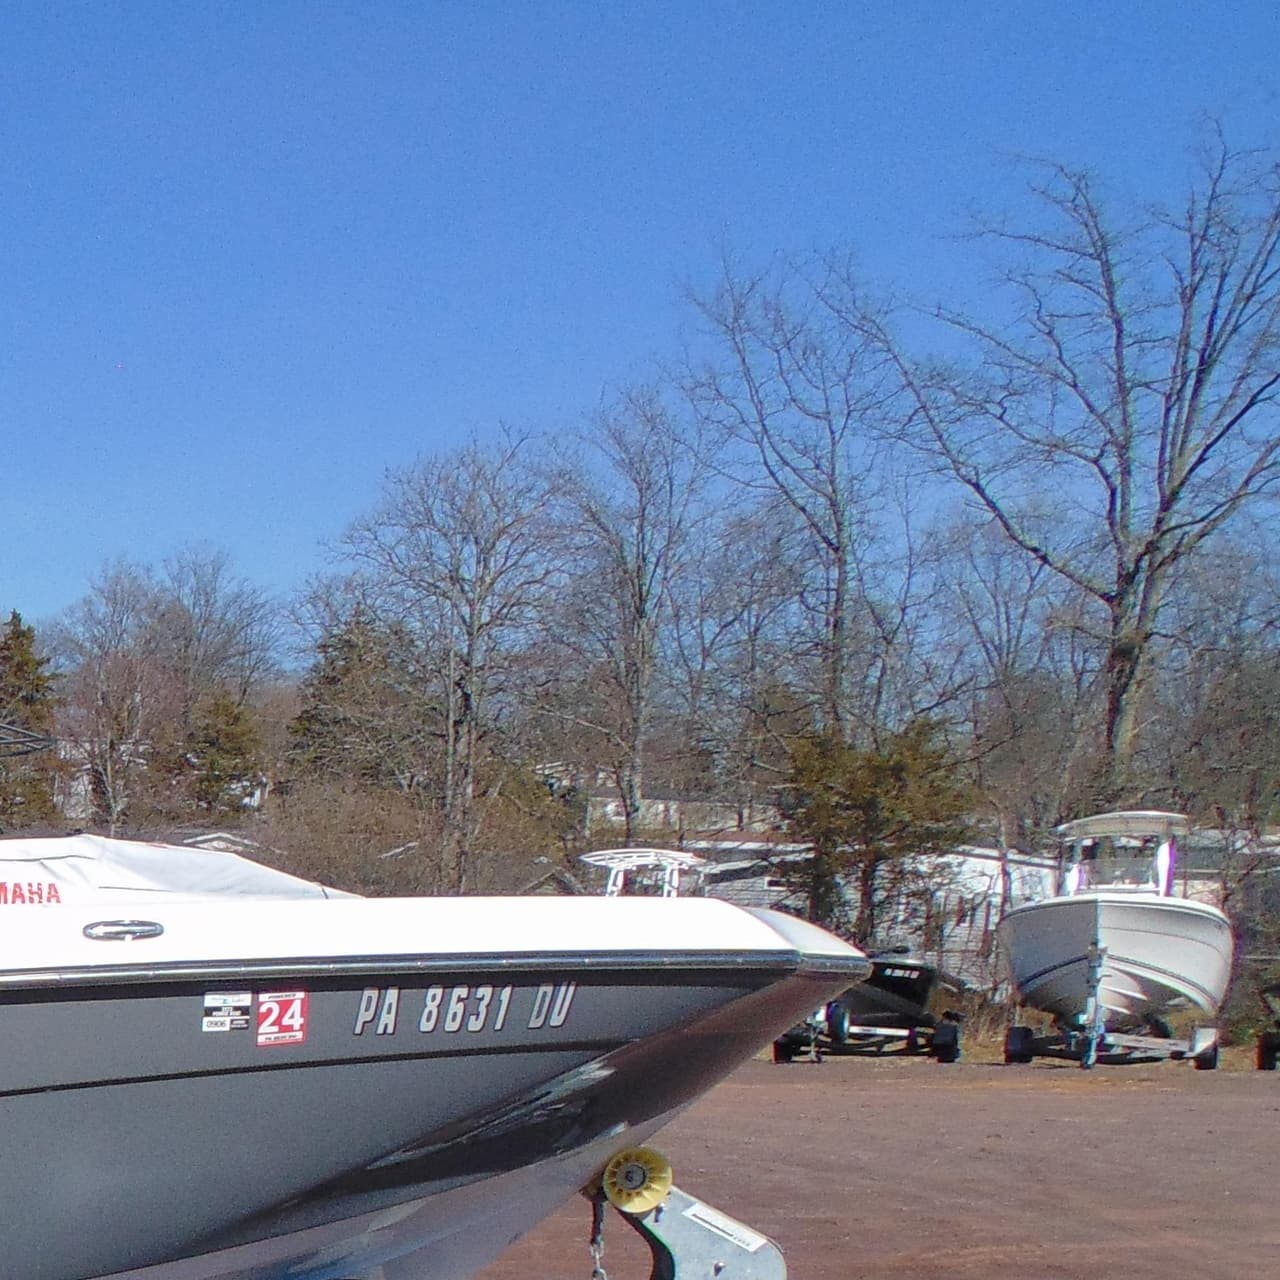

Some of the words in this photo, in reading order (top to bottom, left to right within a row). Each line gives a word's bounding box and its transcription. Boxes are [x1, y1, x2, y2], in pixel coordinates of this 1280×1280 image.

[257, 999, 304, 1034] 24
[353, 986, 400, 1036] PA
[418, 984, 513, 1033] 8631
[527, 982, 576, 1030] DU
